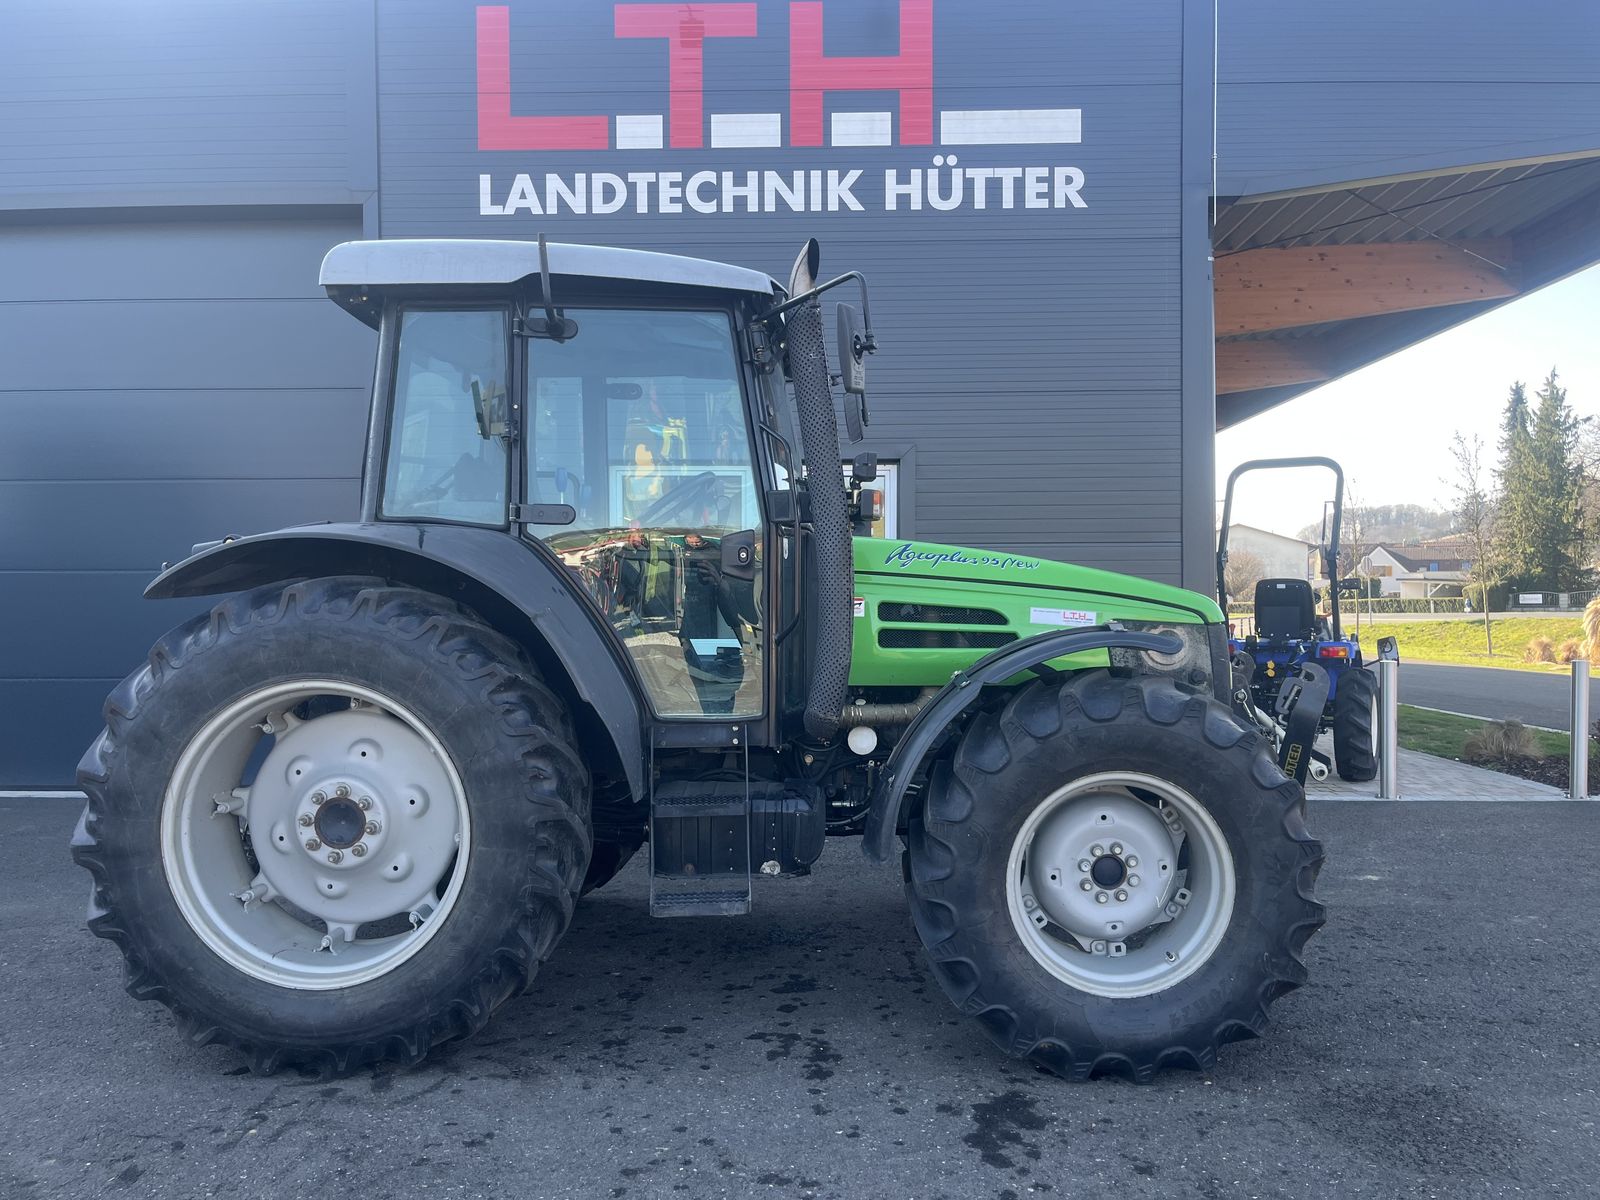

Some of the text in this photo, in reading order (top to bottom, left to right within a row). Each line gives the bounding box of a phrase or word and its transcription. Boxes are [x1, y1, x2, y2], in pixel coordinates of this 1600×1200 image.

[478, 155, 1088, 215] LANDTECHNIK HÜTTER
[885, 543, 978, 568] Agroplus
[1284, 743, 1302, 779] UTER
